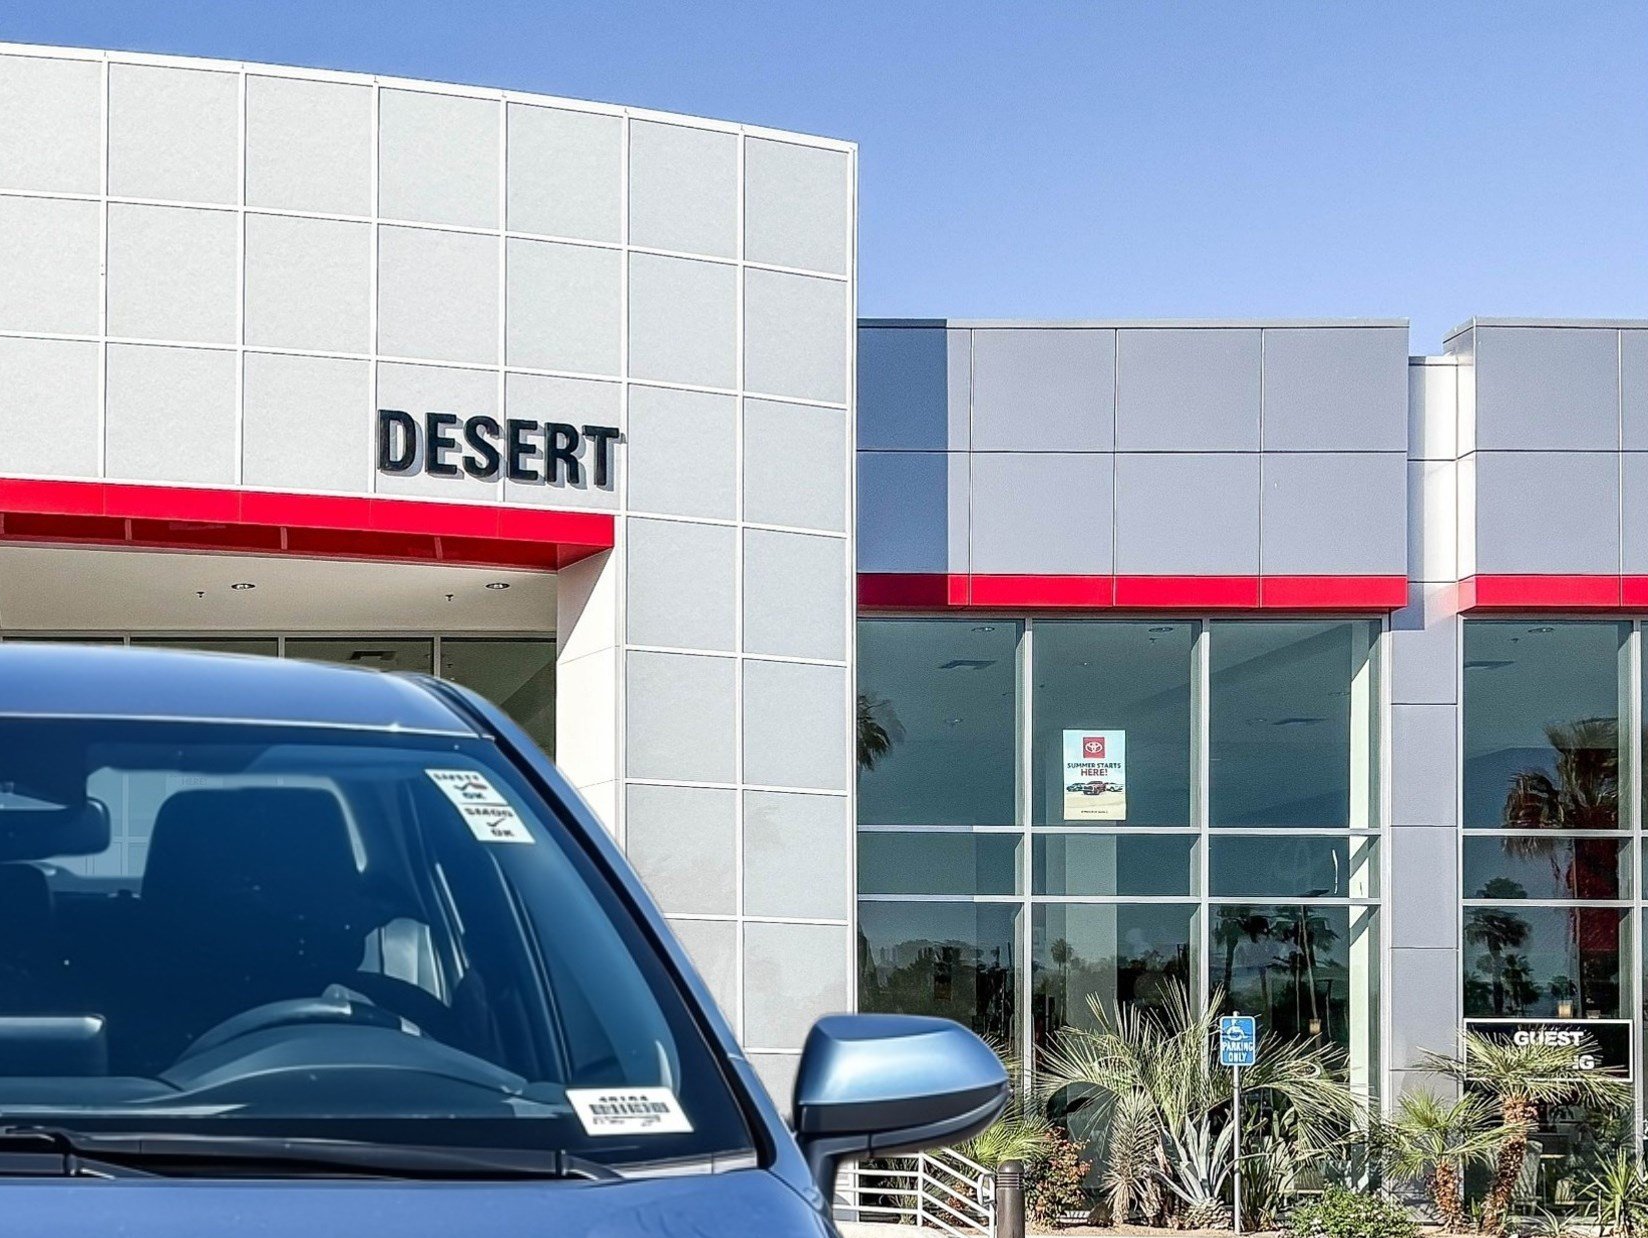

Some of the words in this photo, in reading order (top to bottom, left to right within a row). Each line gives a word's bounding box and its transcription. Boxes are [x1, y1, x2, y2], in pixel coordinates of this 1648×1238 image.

[377, 409, 620, 487] DESERT
[1080, 768, 1108, 777] HERE!
[1513, 1030, 1584, 1047] GUEST
[1222, 1041, 1254, 1052] PARKING
[1228, 1052, 1248, 1063] ONLY
